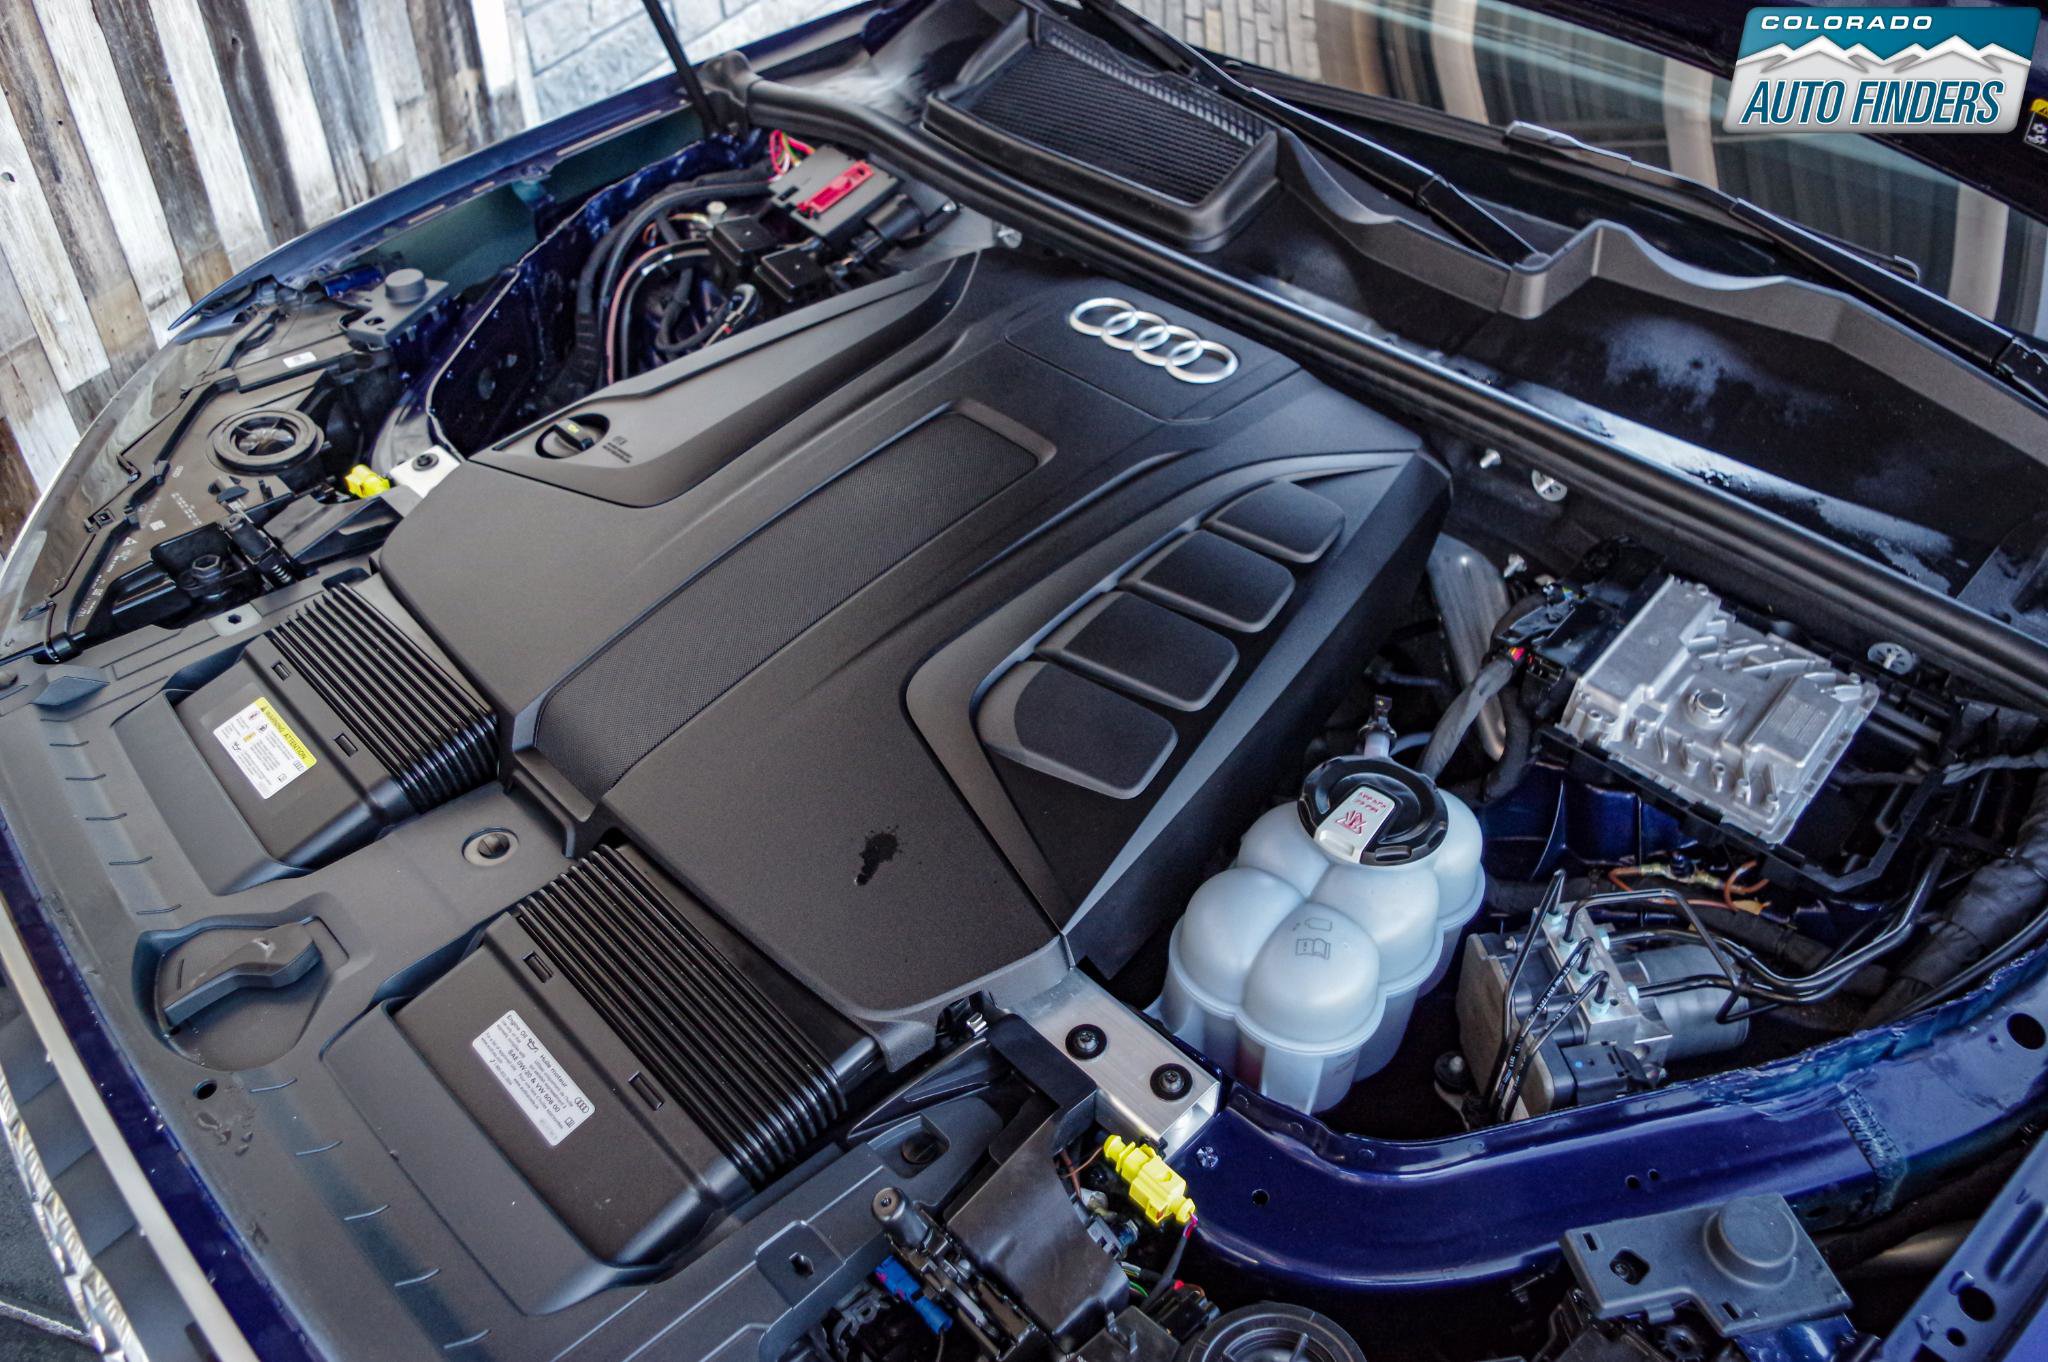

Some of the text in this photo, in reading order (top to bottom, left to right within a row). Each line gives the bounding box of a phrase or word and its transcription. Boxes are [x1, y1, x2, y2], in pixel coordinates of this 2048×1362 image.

[283, 733, 308, 760] ATTENTION
[507, 1049, 518, 1061] SAE
[535, 1083, 545, 1094] VW
[551, 1068, 568, 1088] moteur
